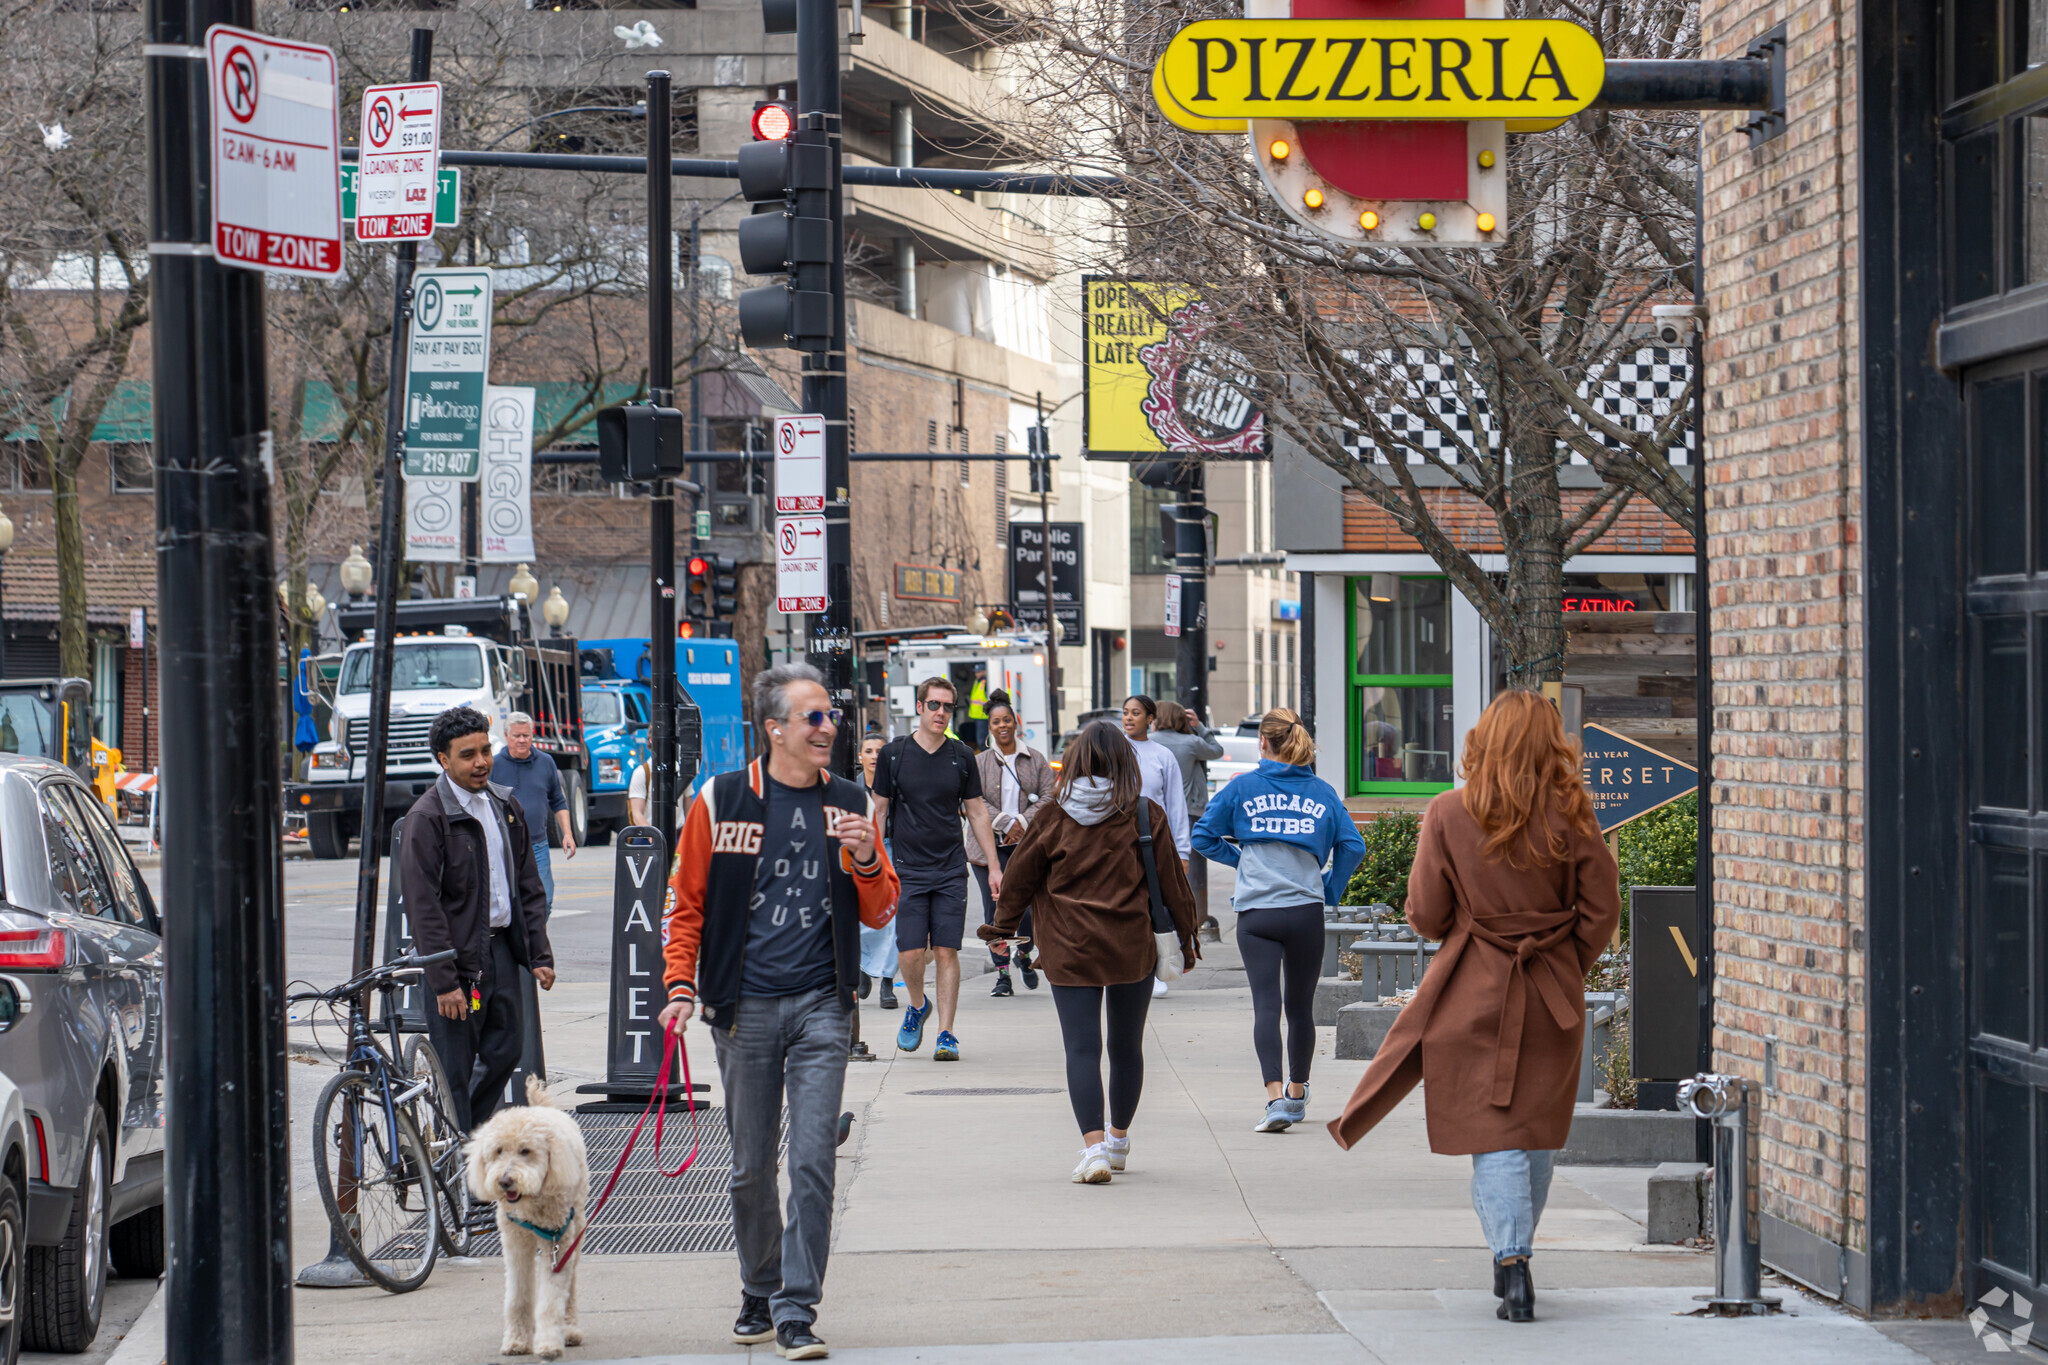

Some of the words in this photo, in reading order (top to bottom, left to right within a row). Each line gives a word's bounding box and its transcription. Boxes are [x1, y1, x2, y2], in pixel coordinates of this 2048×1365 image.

[1188, 36, 1579, 101] PIZZERIA
[402, 131, 432, 147] $91.00
[365, 160, 399, 175] LOADING
[403, 158, 424, 173] ZONE
[405, 188, 427, 202] LAZ
[361, 217, 389, 236] TOW
[393, 215, 427, 235] ZONE
[221, 226, 260, 260] TOW
[267, 235, 330, 269] ZONE
[453, 304, 457, 316] 7
[459, 304, 473, 316] DAY
[458, 319, 478, 328] PARKING
[414, 342, 430, 355] PAY
[431, 342, 442, 355] AT
[444, 342, 461, 355] PAY
[463, 342, 482, 355] BOX
[1095, 343, 1134, 364] LATE
[420, 400, 479, 423] ParkChicago
[422, 452, 446, 473] 219
[447, 453, 472, 473] 407
[488, 397, 525, 537] CHGO
[779, 497, 796, 509] TOW
[799, 496, 820, 509] ZONE
[1021, 529, 1072, 544] Pulic
[1016, 547, 1077, 566] Paring
[780, 563, 802, 573] LOADING
[804, 562, 818, 572] ZONE
[780, 598, 797, 610] TOW
[800, 597, 822, 610] ZONE
[1018, 610, 1041, 621] Daily
[1583, 751, 1600, 759] ALL
[1603, 751, 1629, 759] YEAR
[1242, 793, 1326, 819] CHICAGO
[1250, 817, 1315, 834] CUBS
[624, 855, 653, 1063] VALET
